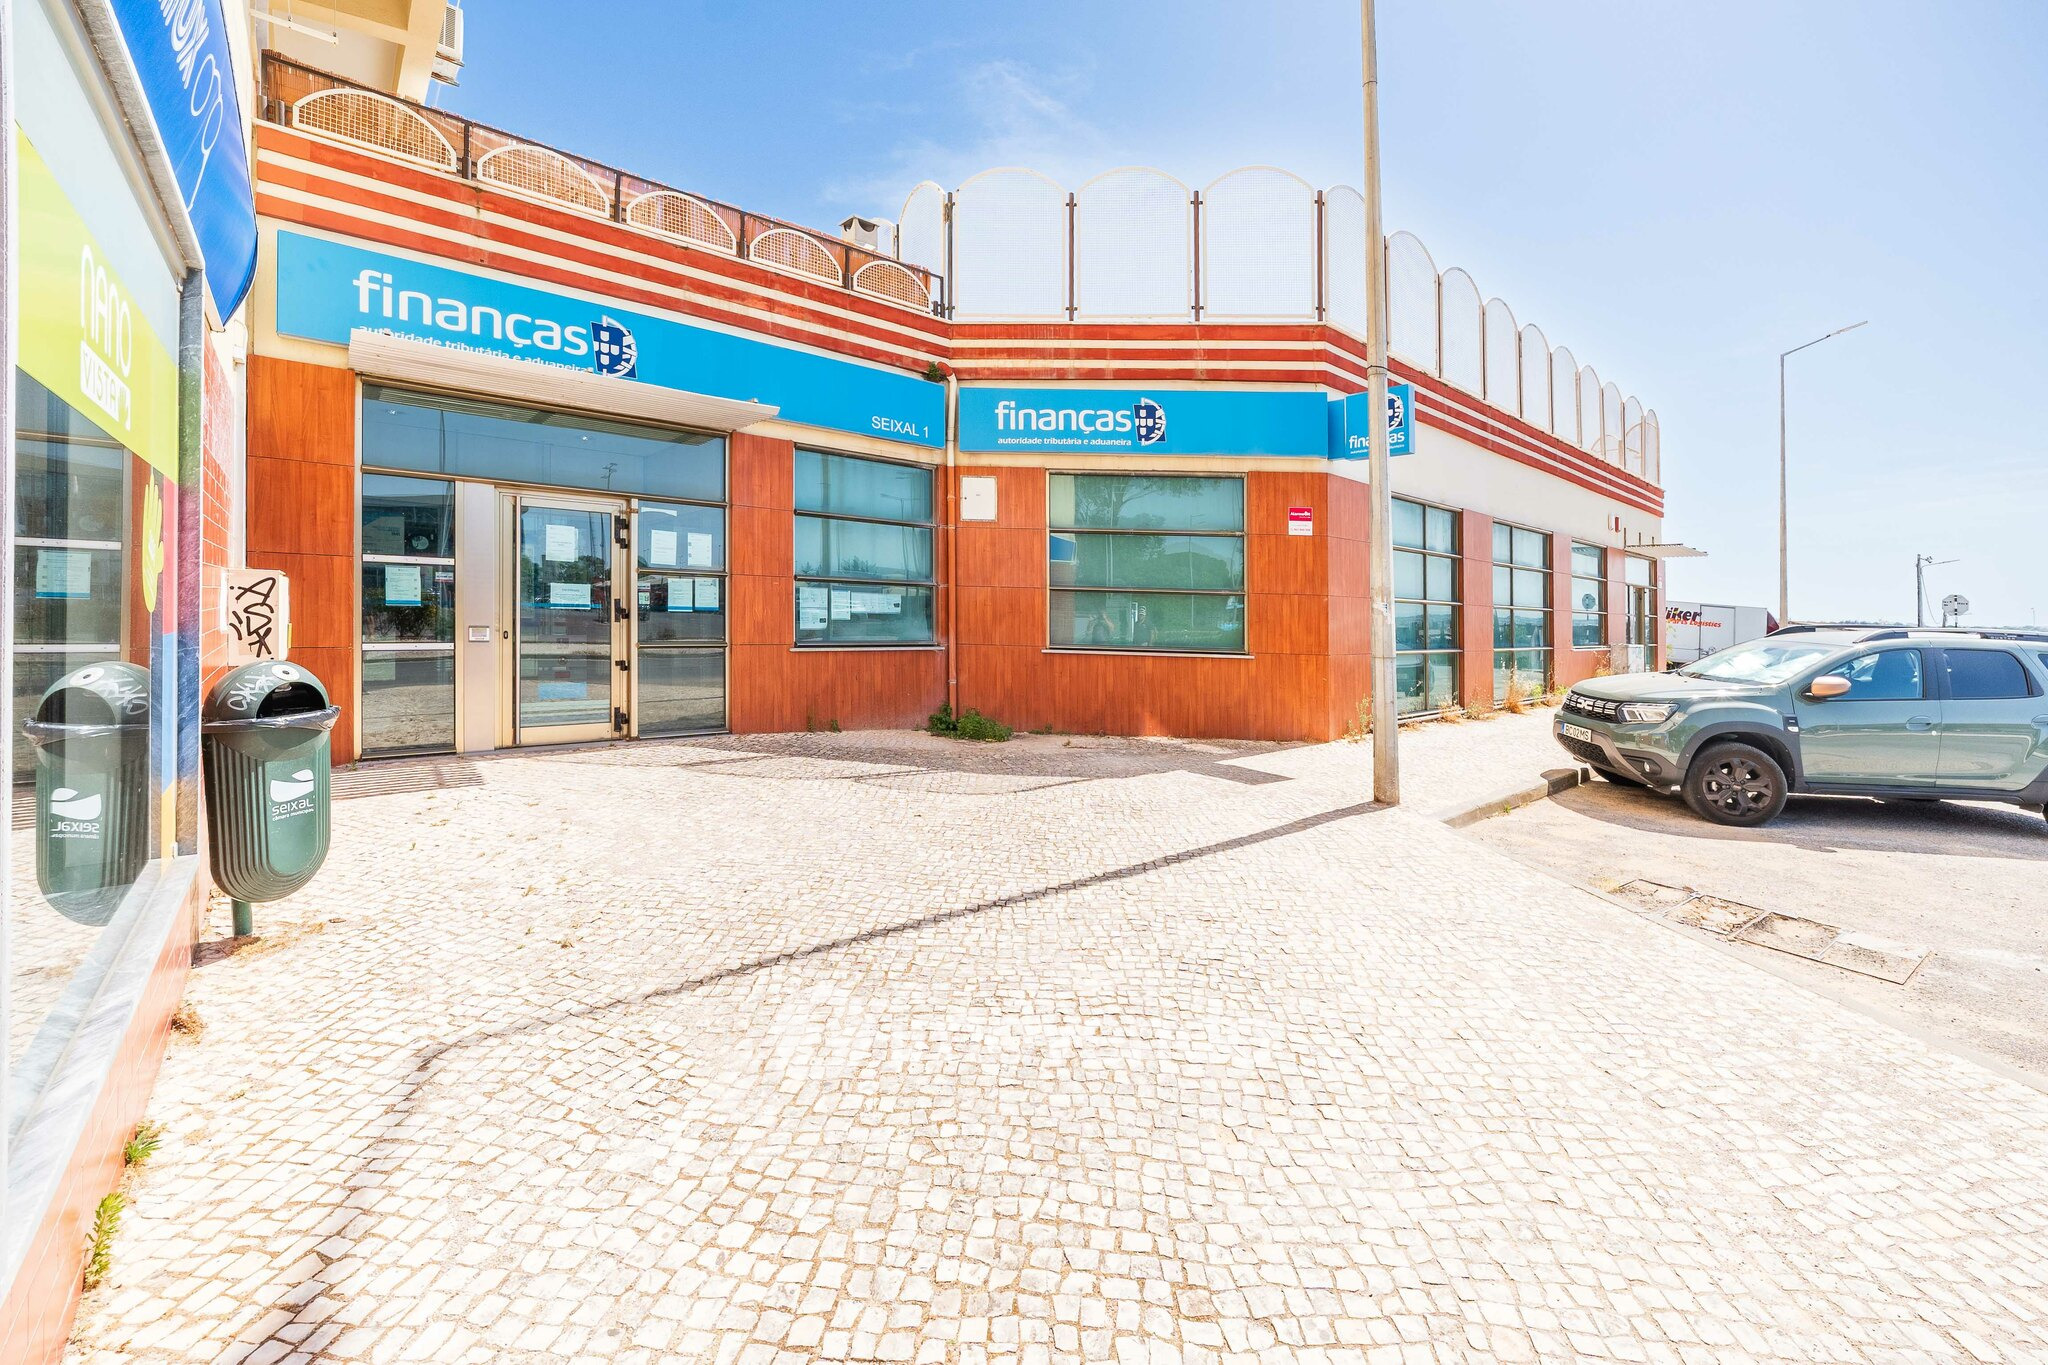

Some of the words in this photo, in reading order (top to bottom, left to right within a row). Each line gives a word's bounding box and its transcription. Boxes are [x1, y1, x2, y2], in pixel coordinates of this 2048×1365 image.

[353, 269, 588, 356] finanças
[84, 352, 120, 406] VISTA
[871, 415, 920, 437] SEIXAL
[923, 426, 929, 438] 1
[995, 401, 1132, 434] finanças
[997, 437, 1042, 445] autoridade
[1043, 437, 1082, 445] tributária
[1090, 438, 1132, 446] aduaneira
[1665, 606, 1702, 622] iker
[1690, 619, 1722, 629] Logistics
